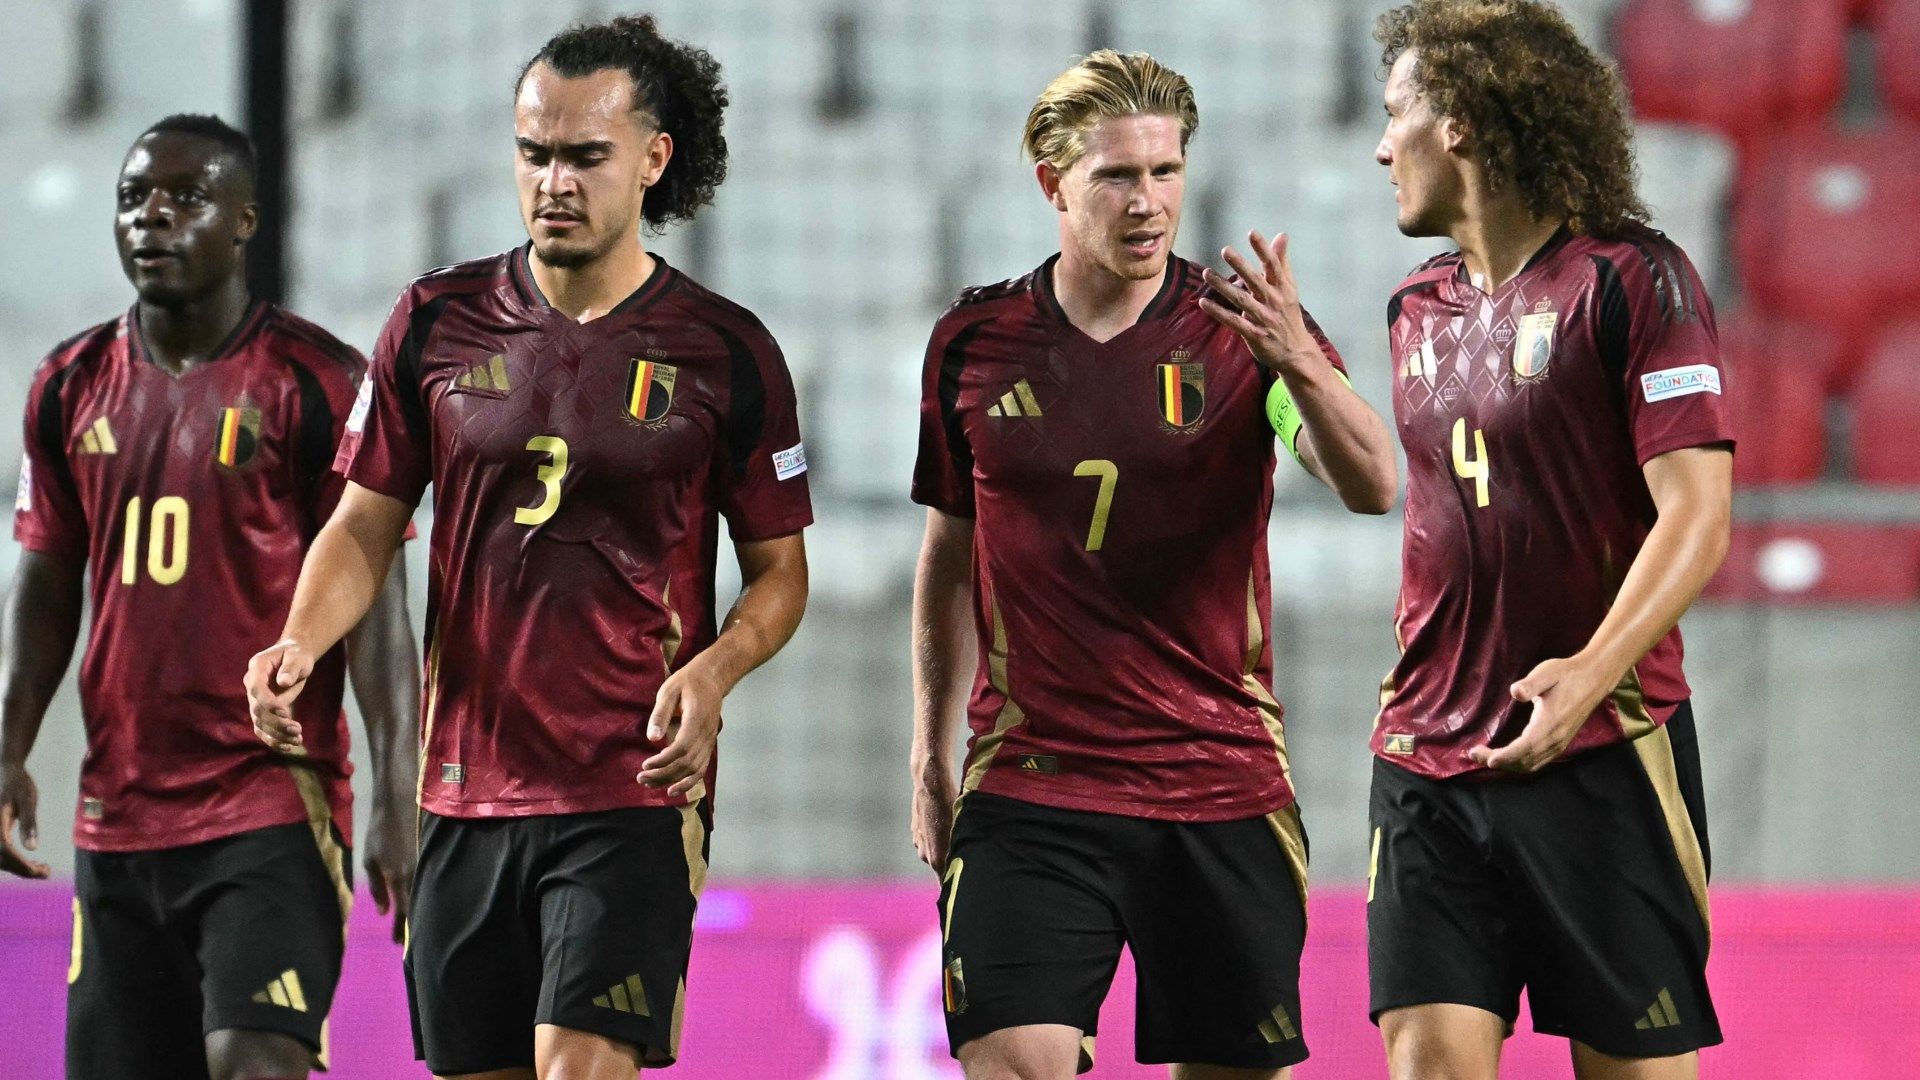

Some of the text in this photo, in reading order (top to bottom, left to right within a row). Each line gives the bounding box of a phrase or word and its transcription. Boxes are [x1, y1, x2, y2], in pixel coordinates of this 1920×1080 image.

[1645, 373, 1718, 392] FOUNDATIO
[514, 435, 568, 526] 3
[1073, 460, 1118, 551] 7
[1452, 417, 1489, 508] 4
[121, 496, 190, 585] 10
